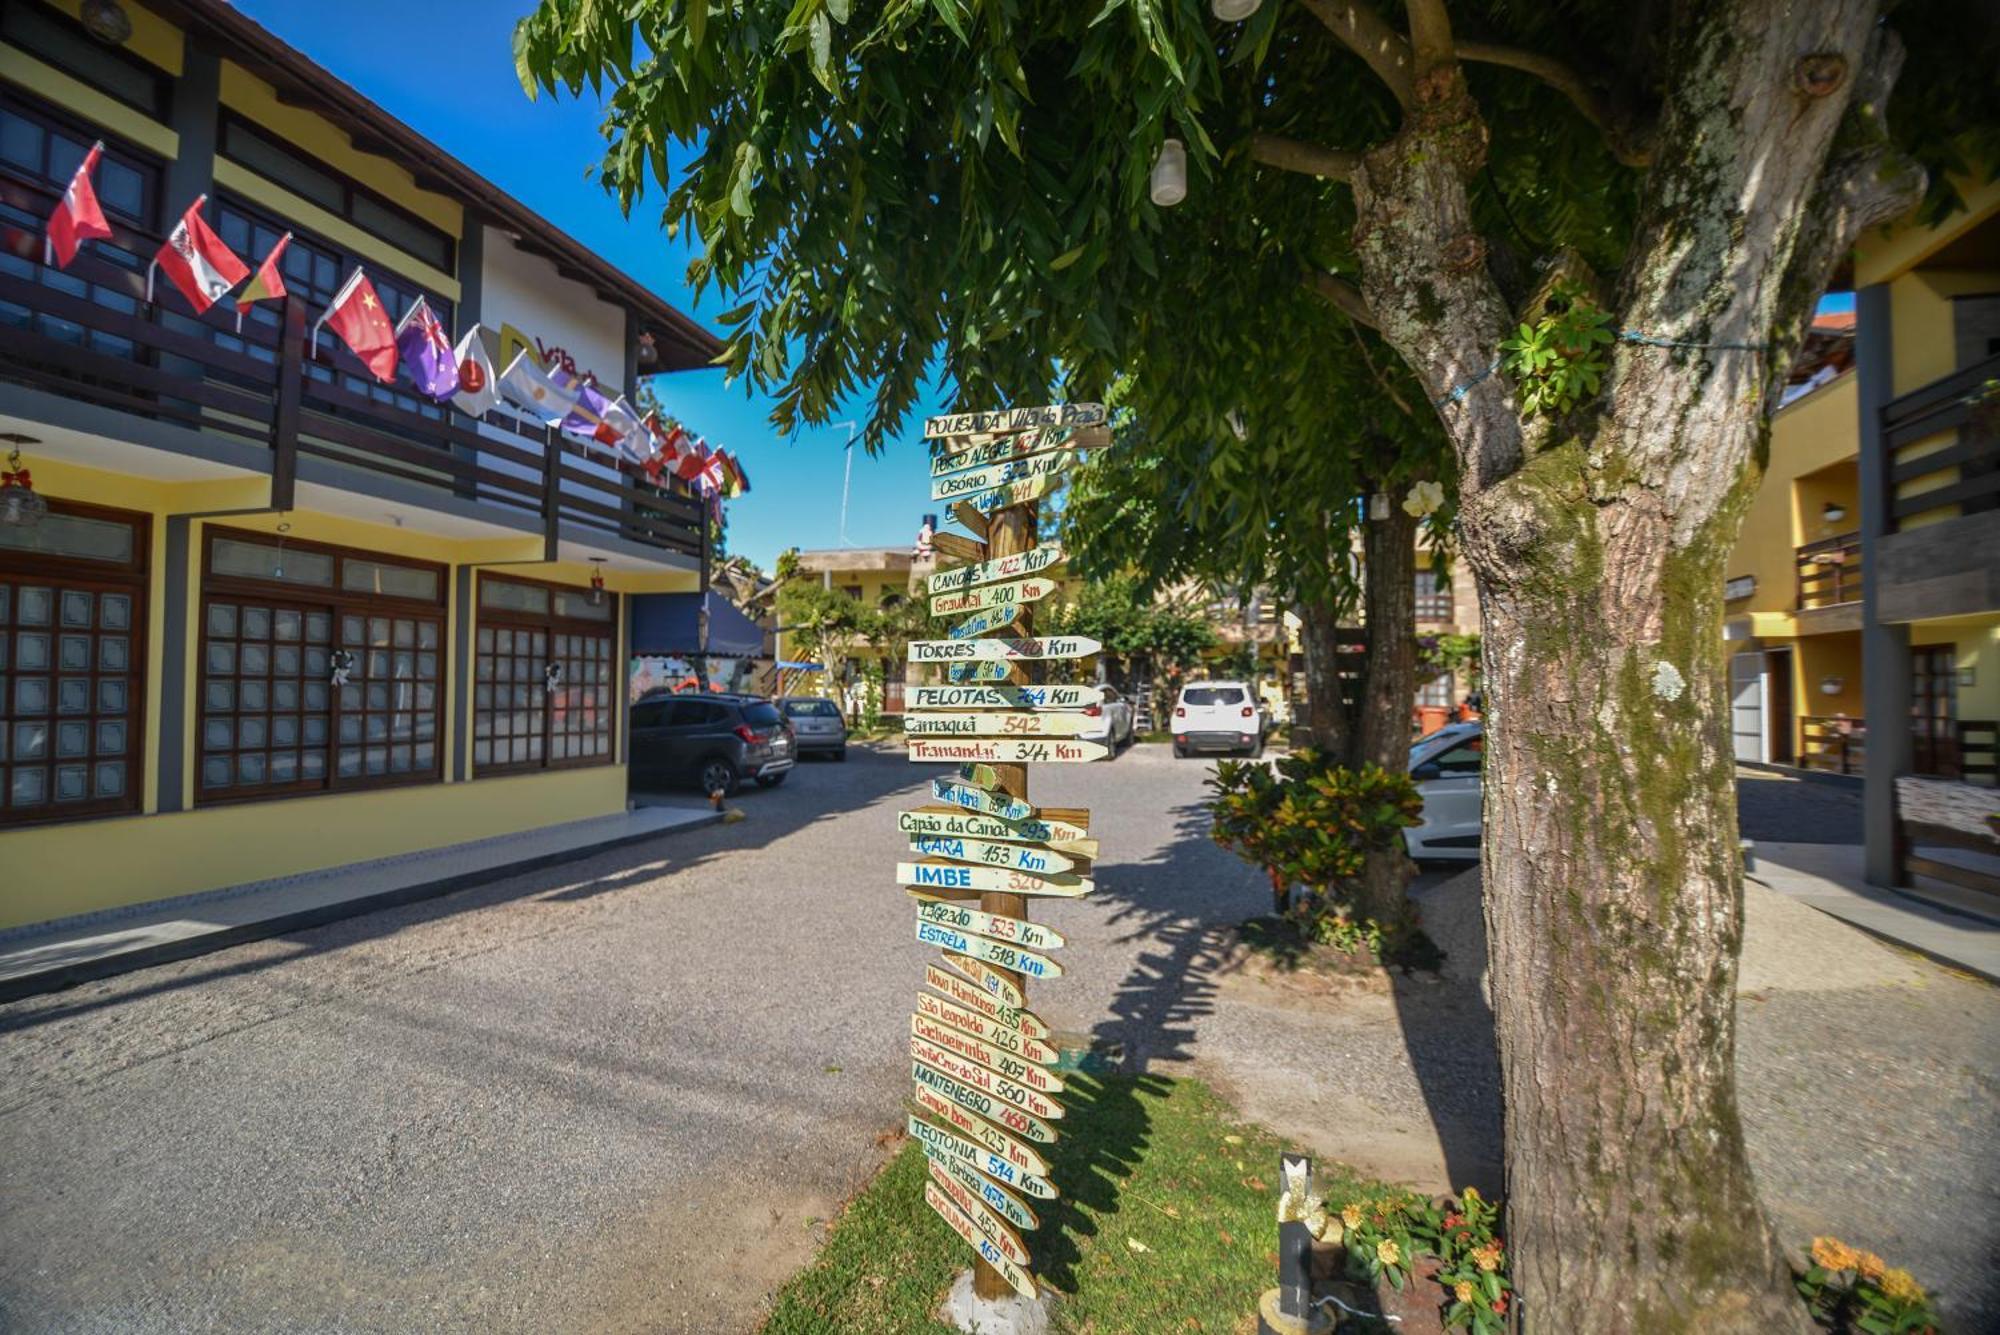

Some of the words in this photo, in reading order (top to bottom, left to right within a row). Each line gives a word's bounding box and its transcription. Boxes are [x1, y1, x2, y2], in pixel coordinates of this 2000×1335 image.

[927, 414, 999, 435] POUSADA
[1009, 410, 1039, 428] Vila
[1062, 404, 1104, 425] Praia
[934, 453, 967, 474] PORTO
[971, 438, 1011, 467] ALEGRE
[1044, 429, 1064, 446] Km
[940, 473, 987, 495] OSÓRIO
[1032, 457, 1056, 475] Km
[933, 568, 981, 591] CANOAS
[998, 558, 1020, 574] 422
[1024, 548, 1048, 571] Km
[992, 587, 1014, 604] 400
[1022, 583, 1040, 598] Km
[914, 643, 976, 658] TORRES
[1048, 639, 1077, 655] Km
[916, 688, 1000, 705] PELOTAS
[1050, 689, 1079, 704] Km
[1003, 717, 1041, 733] 542
[1015, 742, 1050, 761] 344
[1055, 744, 1082, 759] Km
[900, 814, 942, 836] Capão
[946, 815, 963, 831] da
[965, 817, 1010, 838] Canoa
[1018, 823, 1051, 840] 295
[1053, 826, 1077, 841] Km
[916, 836, 964, 858] IÇARA
[983, 846, 1010, 864] 153
[1018, 850, 1046, 870] Km
[989, 917, 1016, 938] 523
[1021, 926, 1044, 946] Km
[918, 923, 967, 952] ESTRELA
[989, 945, 1016, 967] 518
[1019, 954, 1044, 976] Km
[919, 995, 938, 1014] São
[940, 1001, 984, 1034] Leopoldo
[991, 1027, 1018, 1050] 426
[1023, 1039, 1042, 1061] Km
[996, 1005, 1020, 1030] 435
[1020, 1016, 1037, 1037] Km
[1000, 1057, 1026, 1080] 407
[1026, 1066, 1046, 1088] Km
[914, 1064, 991, 1114] MONTENEGRO
[1027, 1120, 1045, 1141] Km
[959, 1065, 971, 1080] do
[972, 1067, 990, 1089] Sul
[996, 1079, 1026, 1104] 560
[1028, 1093, 1047, 1116] Km
[918, 1085, 948, 1116] Campo
[980, 1126, 1006, 1154] 425
[1009, 1143, 1028, 1168] Km
[987, 1153, 1014, 1182] 514
[1020, 1172, 1044, 1196] Km
[1006, 1200, 1023, 1226] Km
[978, 1210, 997, 1241] 452
[999, 1231, 1016, 1260] Km
[979, 1239, 1001, 1263] 167
[1003, 1260, 1020, 1287] Km
